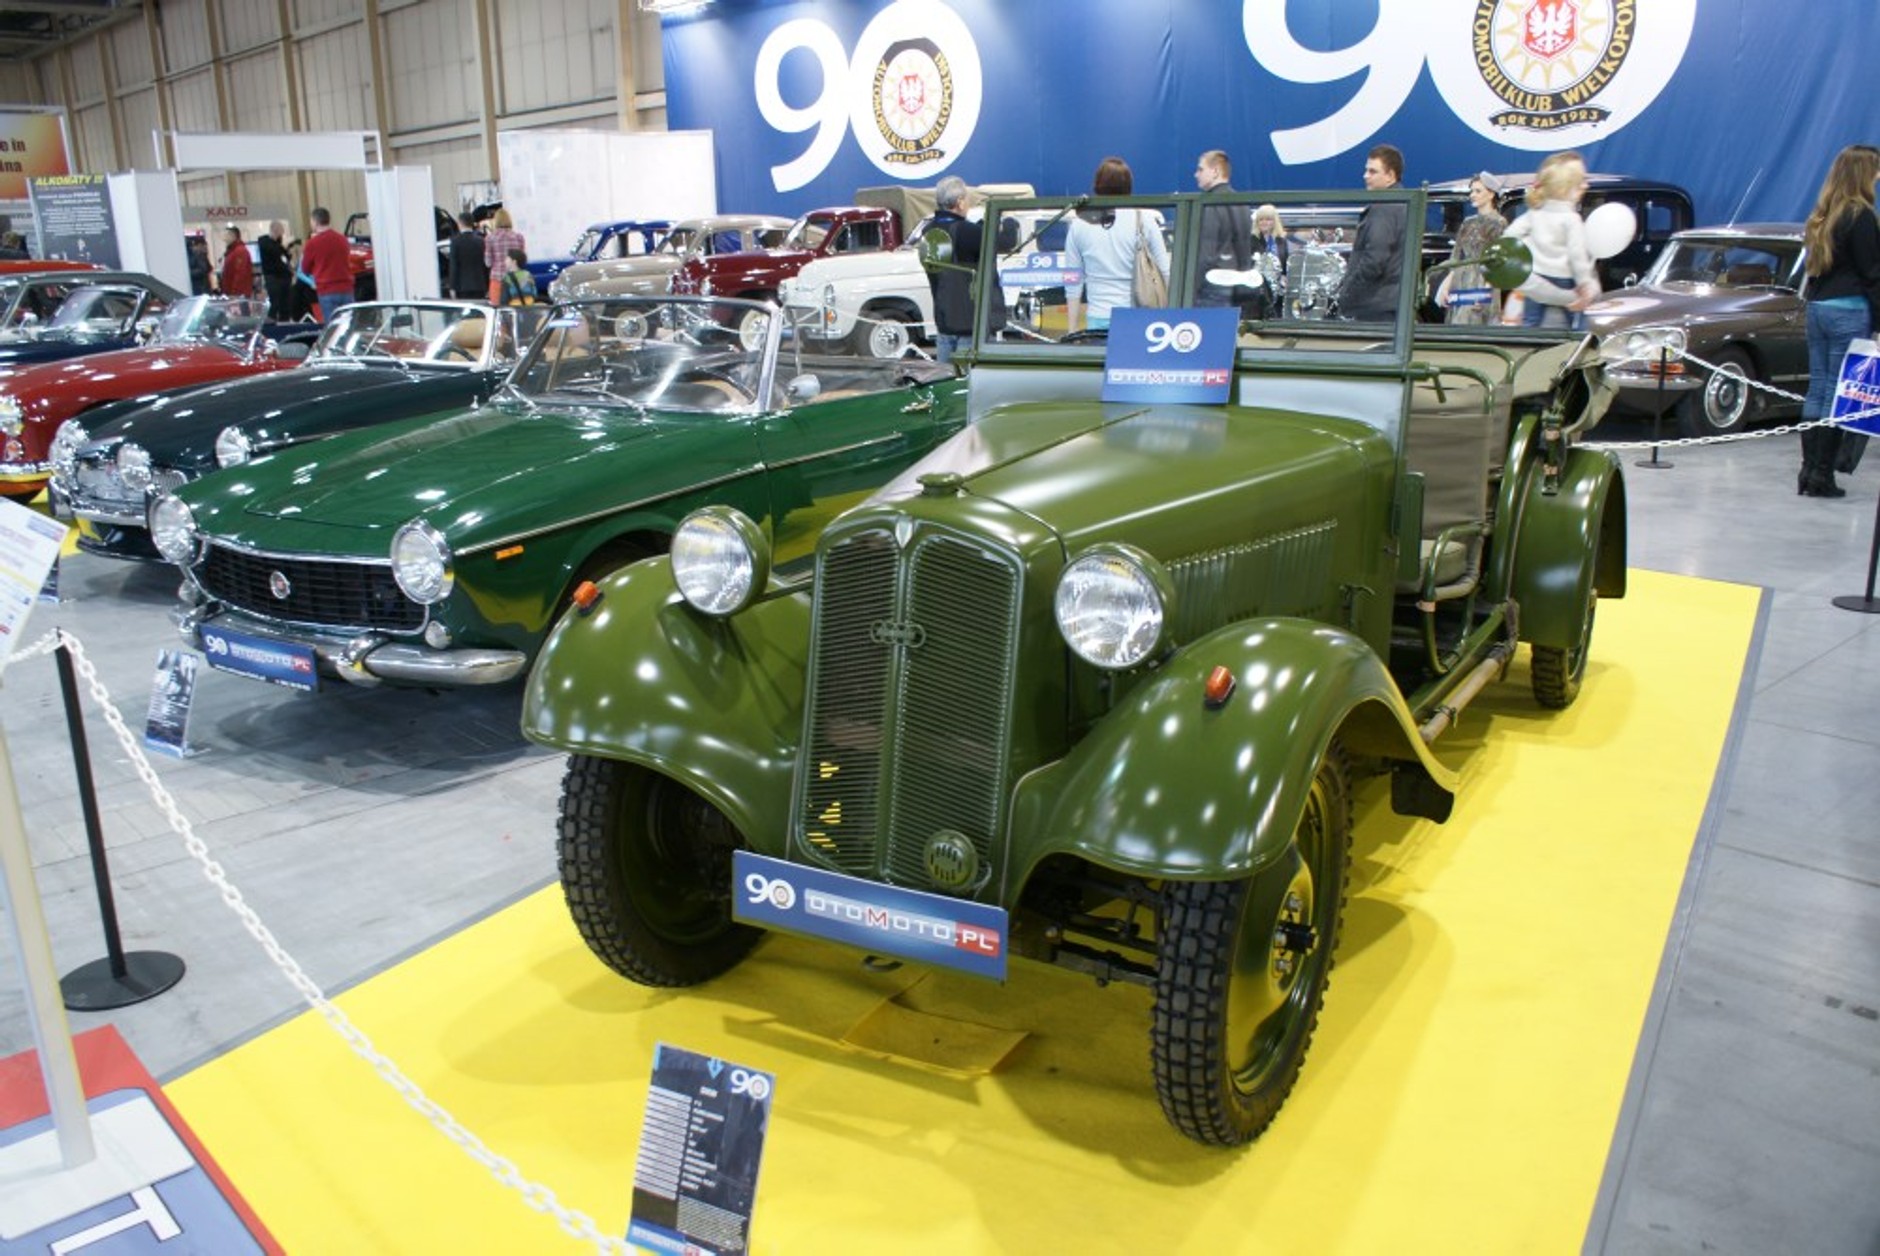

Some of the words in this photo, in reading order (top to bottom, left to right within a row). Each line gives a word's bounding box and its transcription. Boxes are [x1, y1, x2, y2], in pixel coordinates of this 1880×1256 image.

[755, 0, 982, 192] 90
[1242, 0, 1697, 166] 90
[1498, 115, 1527, 127] ROK
[35, 175, 92, 187] ALKOMATY
[207, 207, 248, 217] XADO
[1032, 255, 1053, 269] 90
[1145, 321, 1202, 353] 90
[205, 634, 228, 656] 90
[745, 873, 796, 910] 90
[808, 894, 995, 952] OTOMOTO.PL
[730, 1068, 770, 1100] 90
